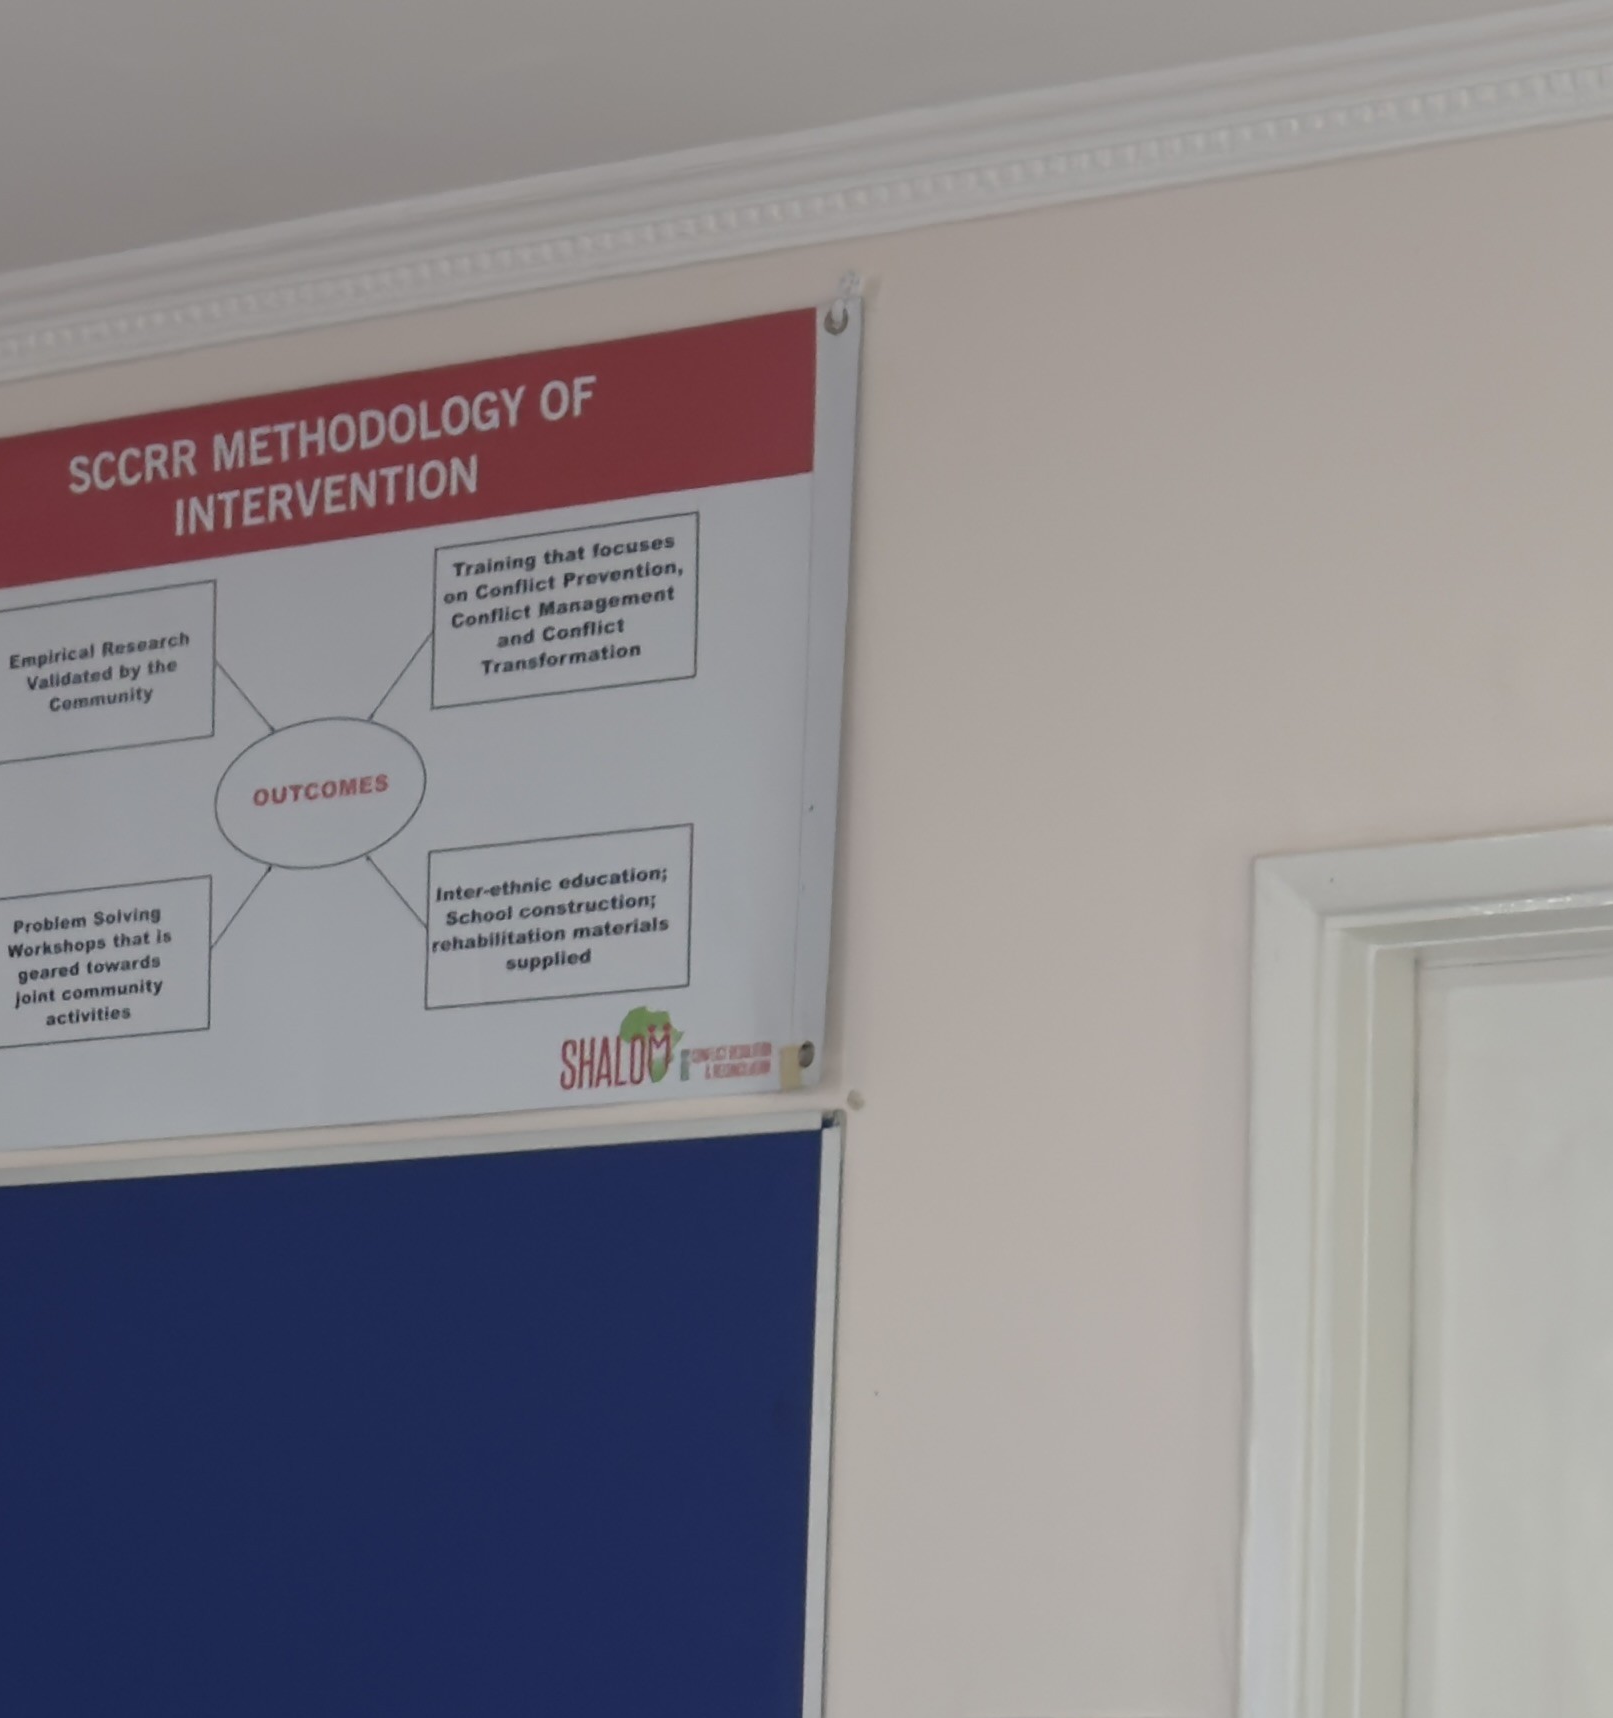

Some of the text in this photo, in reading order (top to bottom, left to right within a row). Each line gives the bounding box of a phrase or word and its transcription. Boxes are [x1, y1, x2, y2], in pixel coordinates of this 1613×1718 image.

[69, 375, 598, 495] SCCRR METHODOLOGY OF
[175, 455, 479, 537] INTERVENTION
[453, 536, 676, 578] Training that focuses
[443, 561, 684, 605] on Conflict Prevention,
[451, 586, 676, 629] Conflict Management
[497, 618, 625, 649] and Conflict
[9, 632, 191, 671] Empirical Research
[482, 644, 642, 676] Transformation
[27, 659, 178, 691] Validated by the
[49, 687, 155, 713] Community
[253, 774, 389, 806] OUTCOMES
[436, 867, 668, 903] Inter-ethnic education;
[14, 907, 162, 935] Problem Solving
[445, 894, 658, 927] School construction;
[8, 929, 173, 958] Workshops that is
[432, 917, 670, 953] rehabilitation materials
[18, 955, 162, 985] geared towards
[506, 949, 593, 973] supplied
[15, 978, 164, 1010] joint community
[45, 1005, 132, 1027] activities
[560, 1026, 673, 1091] SHALOM
